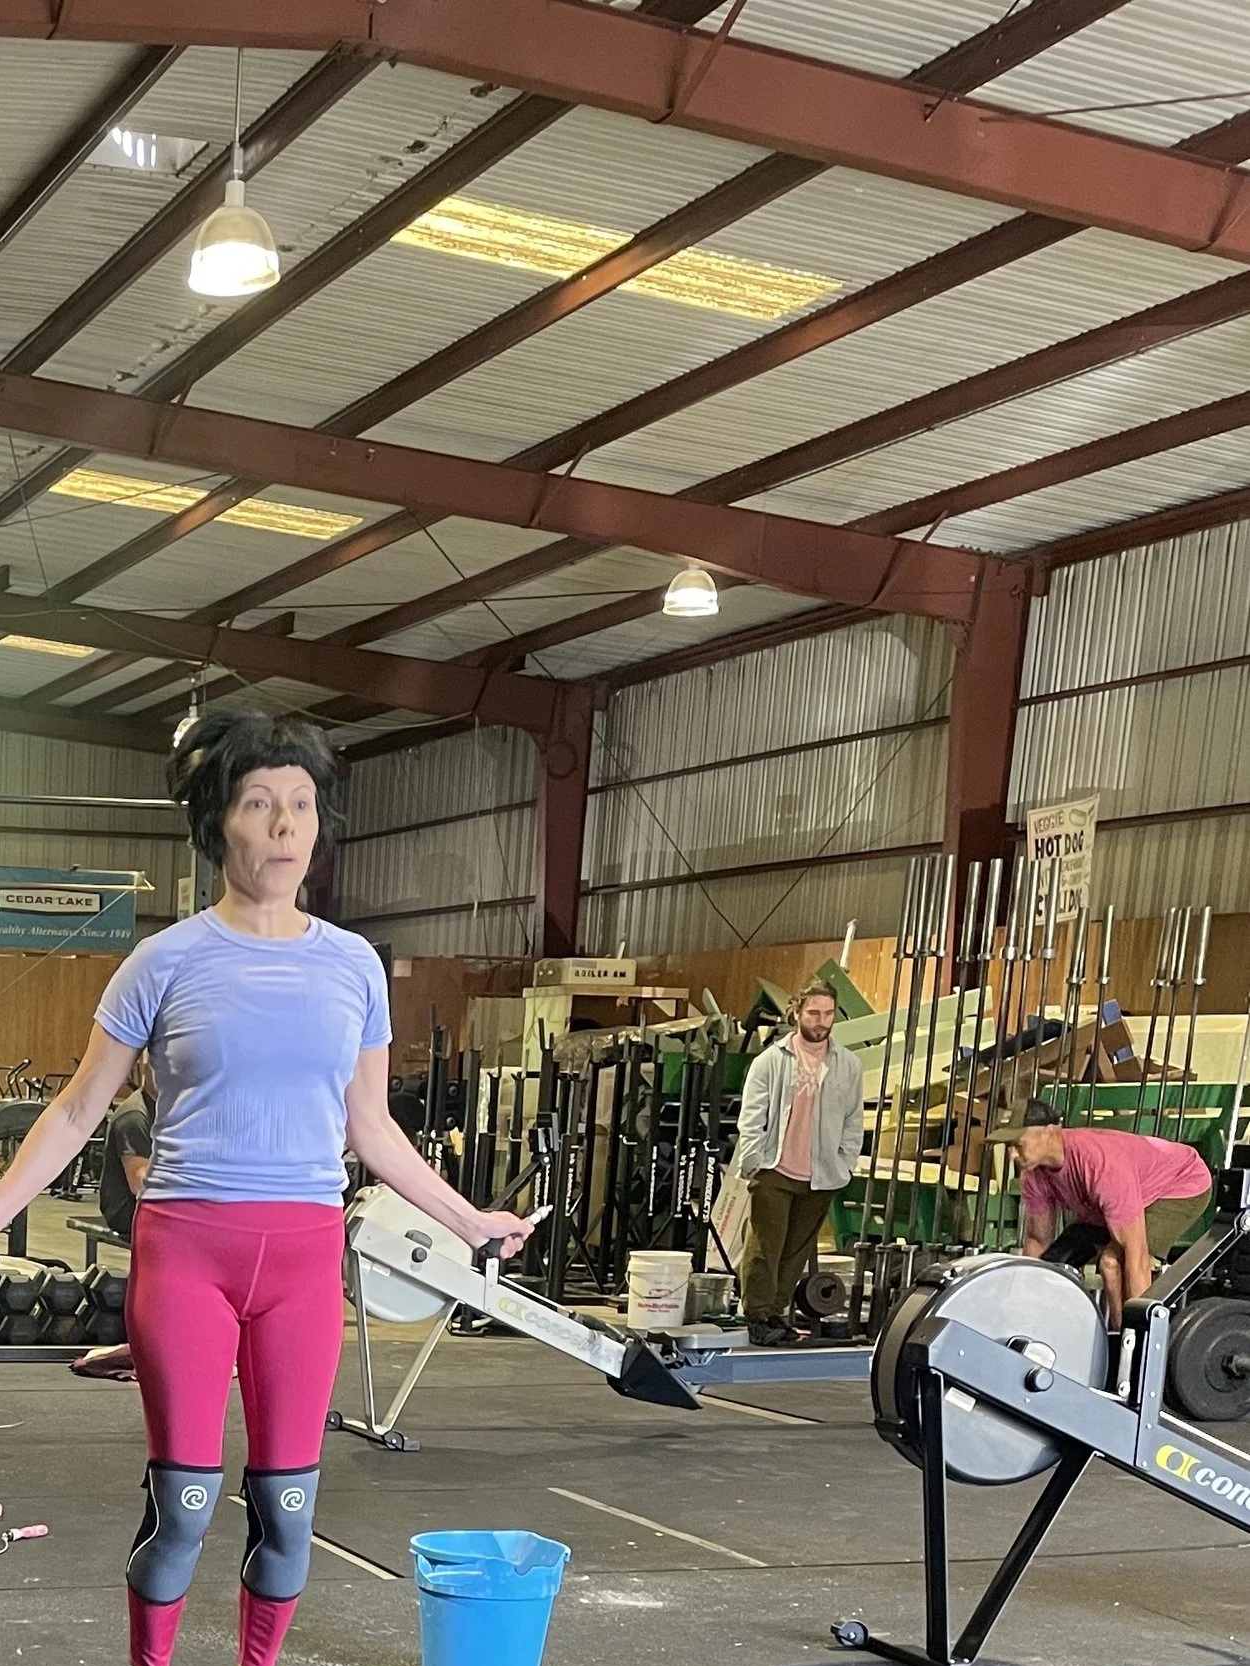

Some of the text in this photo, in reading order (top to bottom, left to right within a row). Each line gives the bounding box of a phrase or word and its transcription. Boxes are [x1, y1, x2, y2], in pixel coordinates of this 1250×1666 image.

[1034, 810, 1065, 834] VEGGIE
[1034, 830, 1084, 859] HOT DOG
[6, 894, 93, 907] CEDAR LAKE
[27, 926, 78, 937] Alternative
[81, 928, 106, 938] Since
